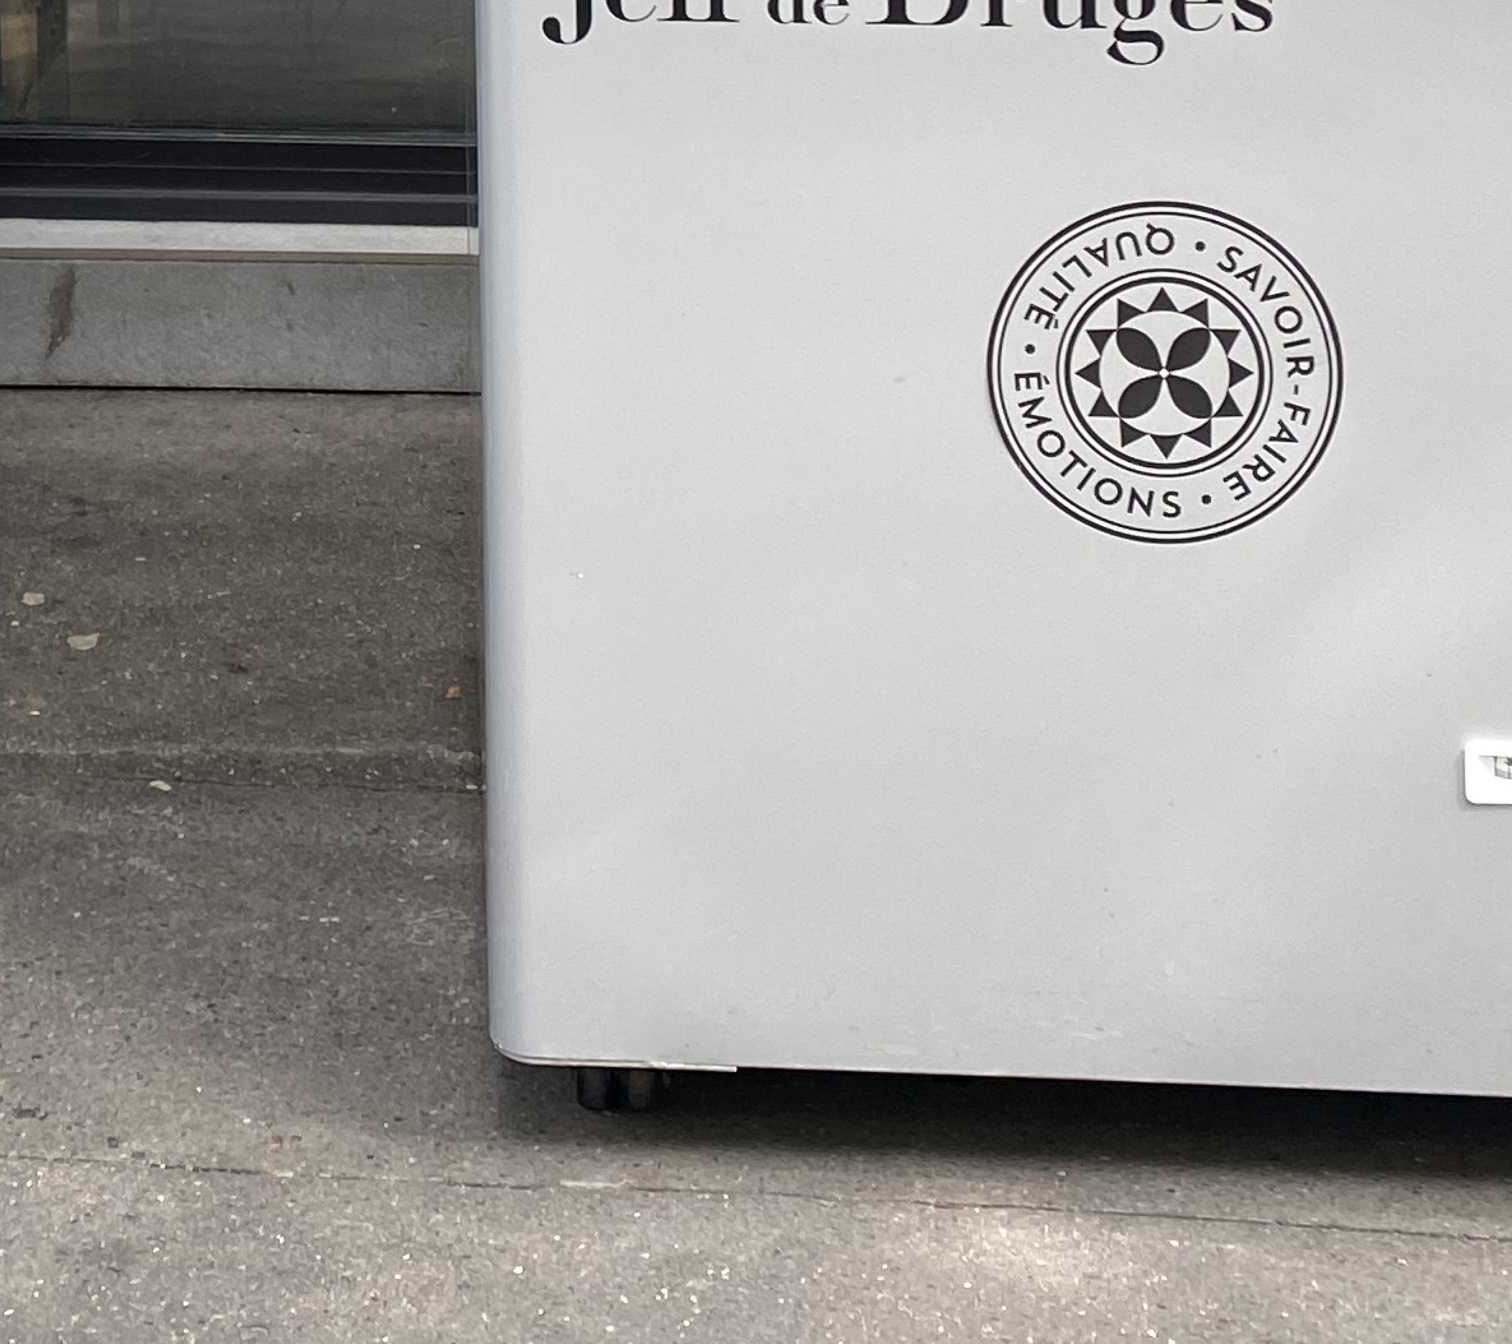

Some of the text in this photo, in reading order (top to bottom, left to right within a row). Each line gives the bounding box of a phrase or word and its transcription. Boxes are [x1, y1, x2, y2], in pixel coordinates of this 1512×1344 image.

[1021, 221, 1178, 331] QUALITÉ
[1011, 368, 1185, 518] ÉMOTIONS
[1214, 243, 1315, 503] SAVOIR-FAIRE
